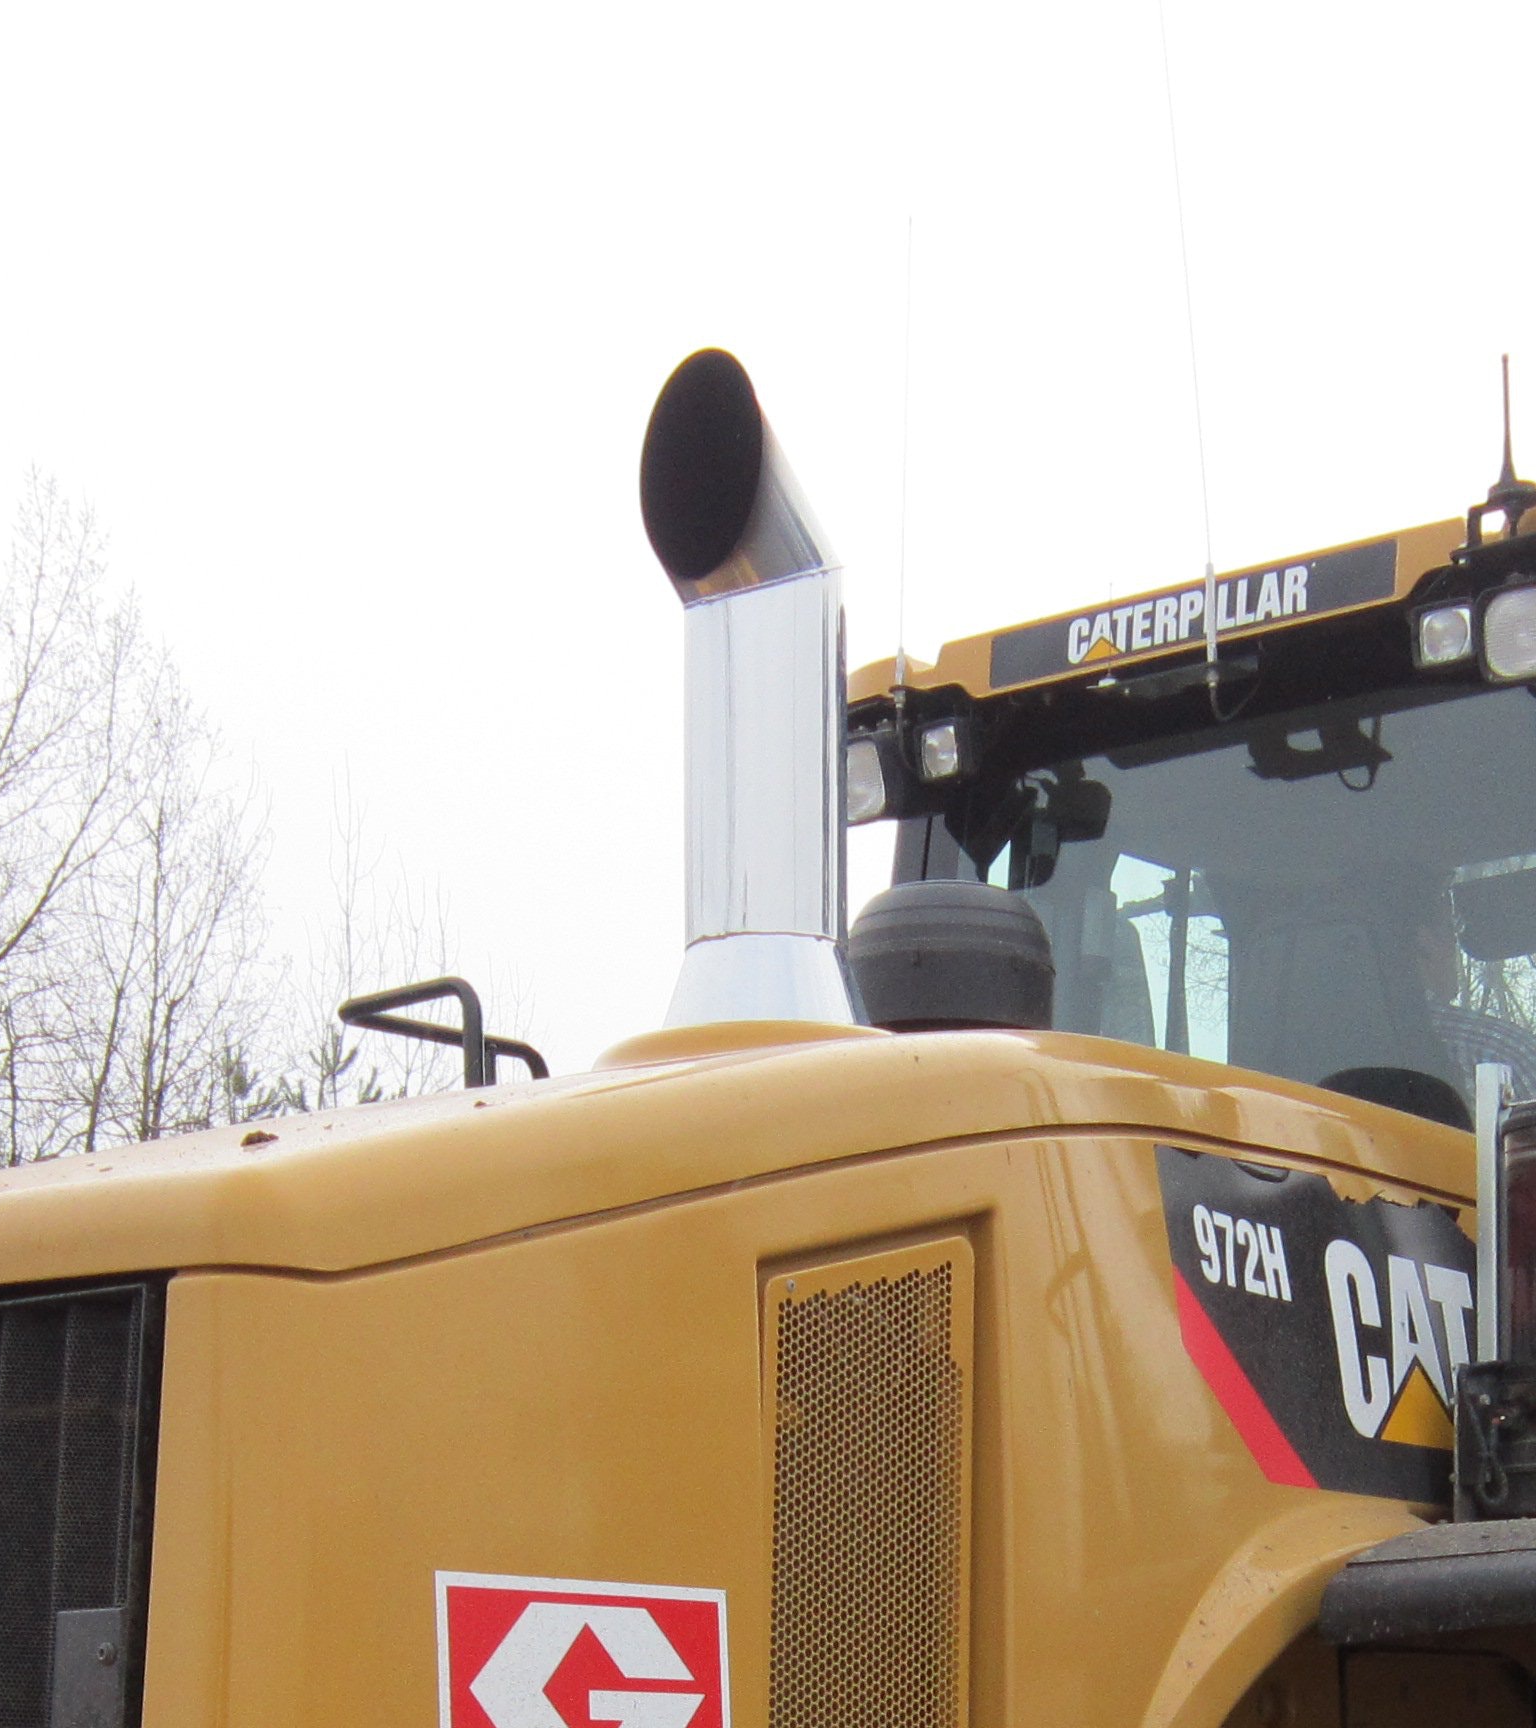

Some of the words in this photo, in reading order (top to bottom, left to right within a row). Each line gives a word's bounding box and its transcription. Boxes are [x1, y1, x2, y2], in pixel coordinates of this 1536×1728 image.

[1067, 564, 1309, 665] CATERPLLAR
[1193, 1203, 1293, 1302] 972H
[1324, 1239, 1474, 1438] CAT
